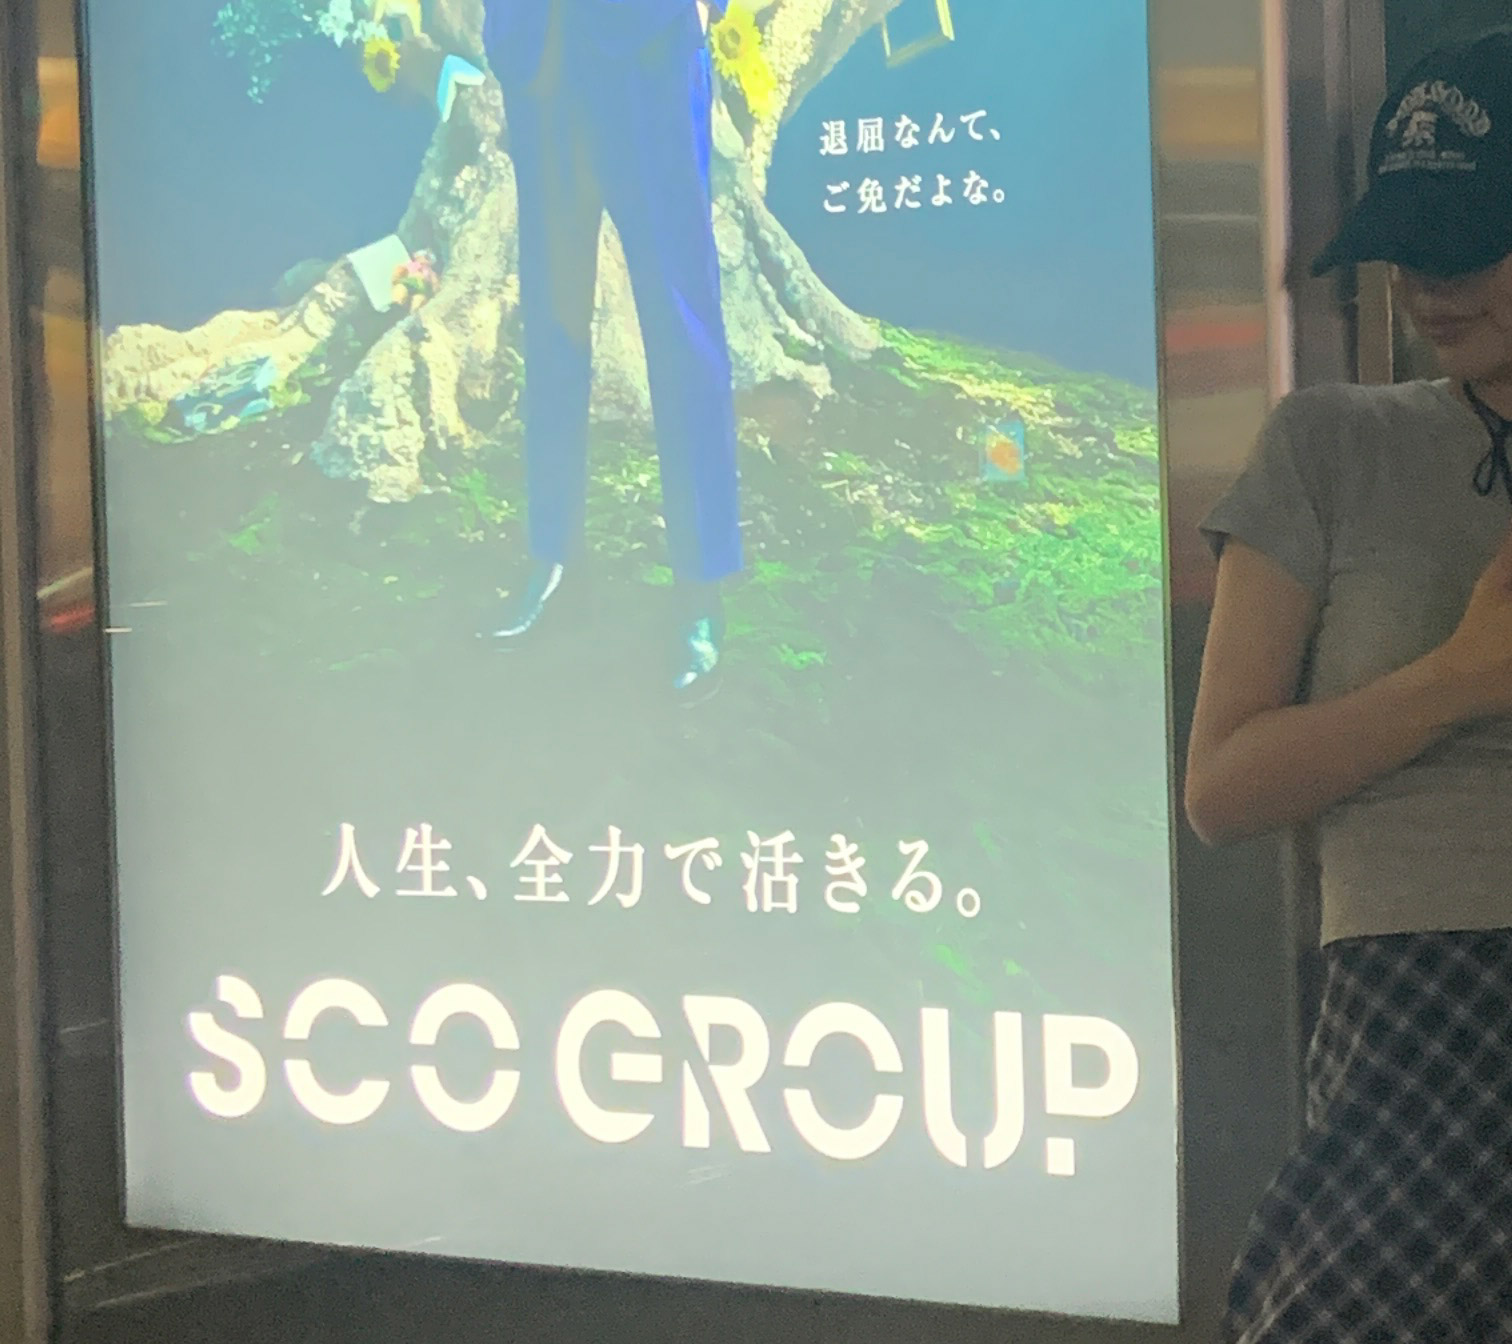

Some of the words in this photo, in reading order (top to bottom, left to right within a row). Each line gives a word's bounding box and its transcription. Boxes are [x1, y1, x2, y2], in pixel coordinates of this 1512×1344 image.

[819, 110, 1001, 156] 退屈なんて、
[823, 170, 1005, 213] ご免だよな。
[321, 822, 983, 919] 人生、全力で活きる。
[187, 974, 521, 1133] SCO
[555, 989, 1140, 1177] GROUP
